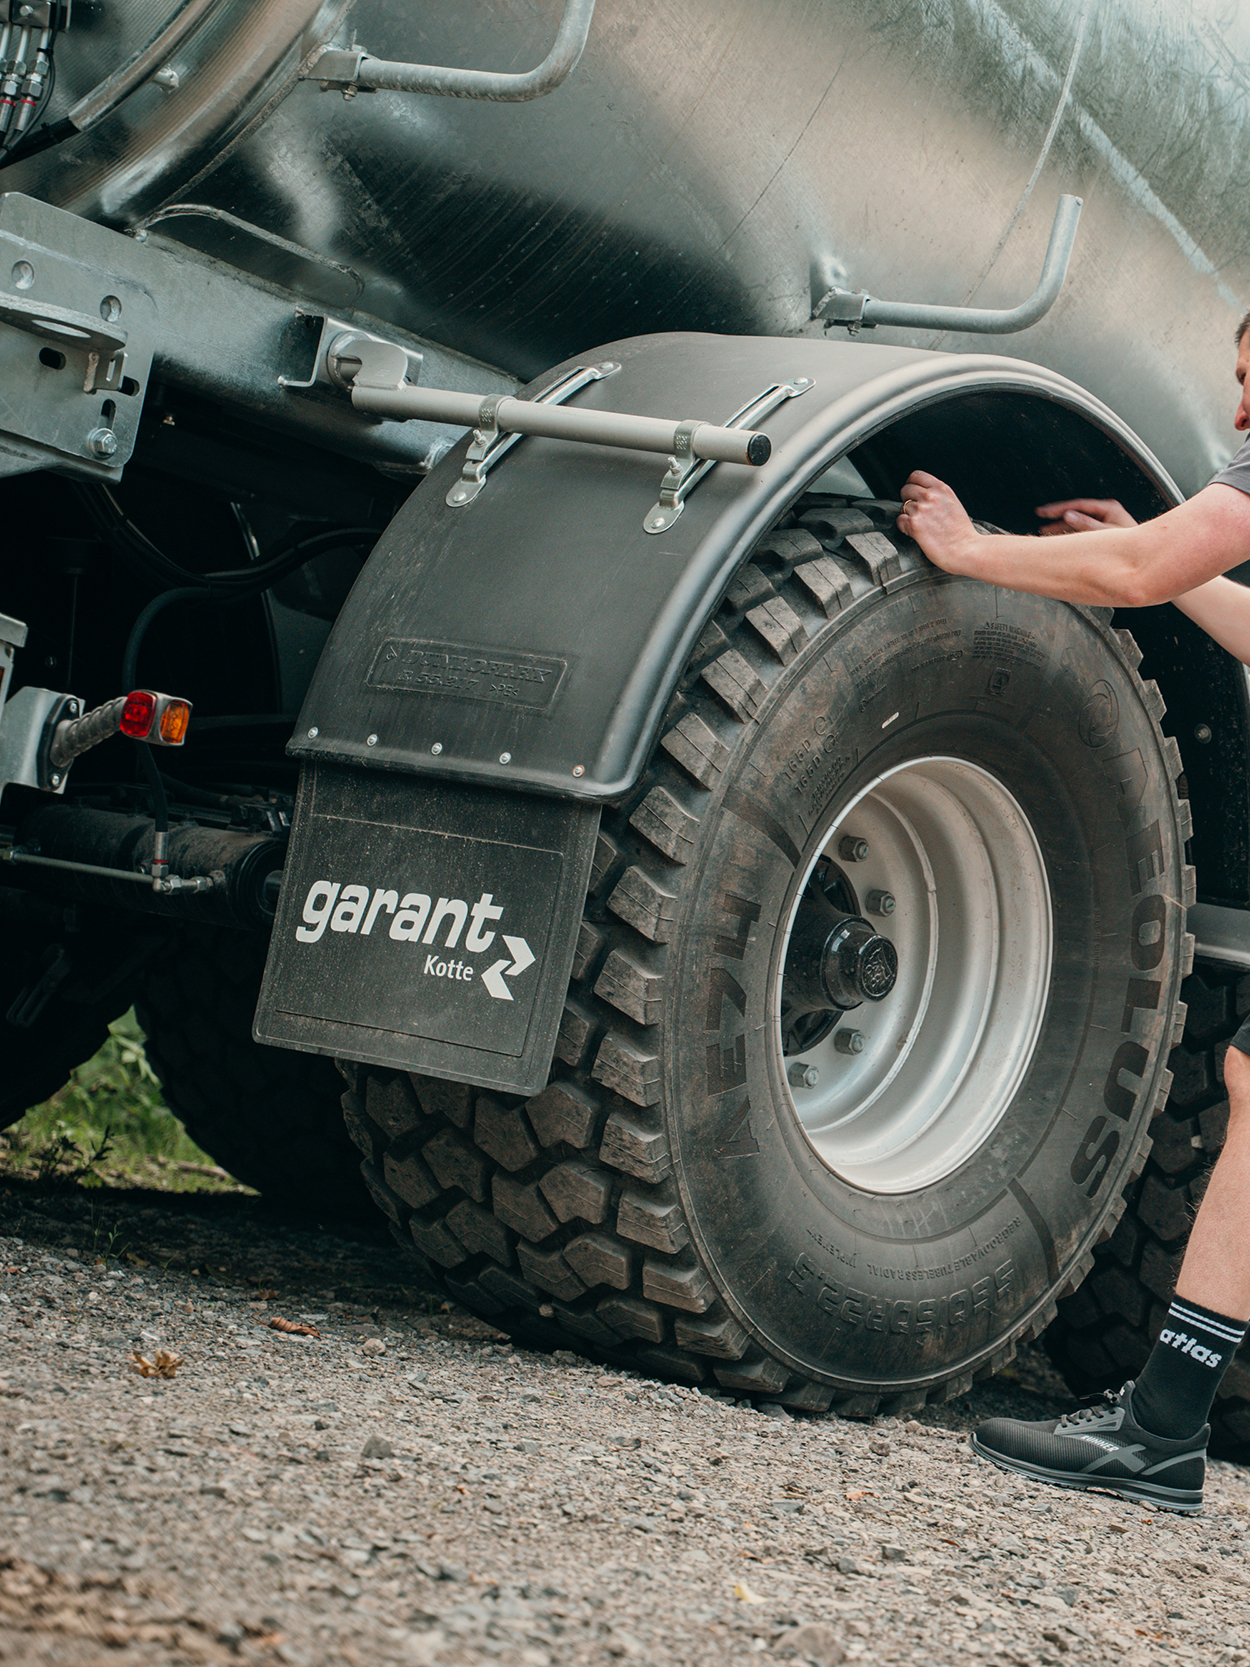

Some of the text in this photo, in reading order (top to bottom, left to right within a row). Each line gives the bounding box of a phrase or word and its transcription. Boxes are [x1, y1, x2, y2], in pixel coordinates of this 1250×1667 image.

[295, 879, 504, 953] garant
[422, 954, 474, 982] Kotte
[1070, 747, 1166, 1200] AEOLUS
[704, 893, 762, 1160] AE74
[1159, 1328, 1223, 1369] atlas
[1079, 1434, 1120, 1454] RUNNER
